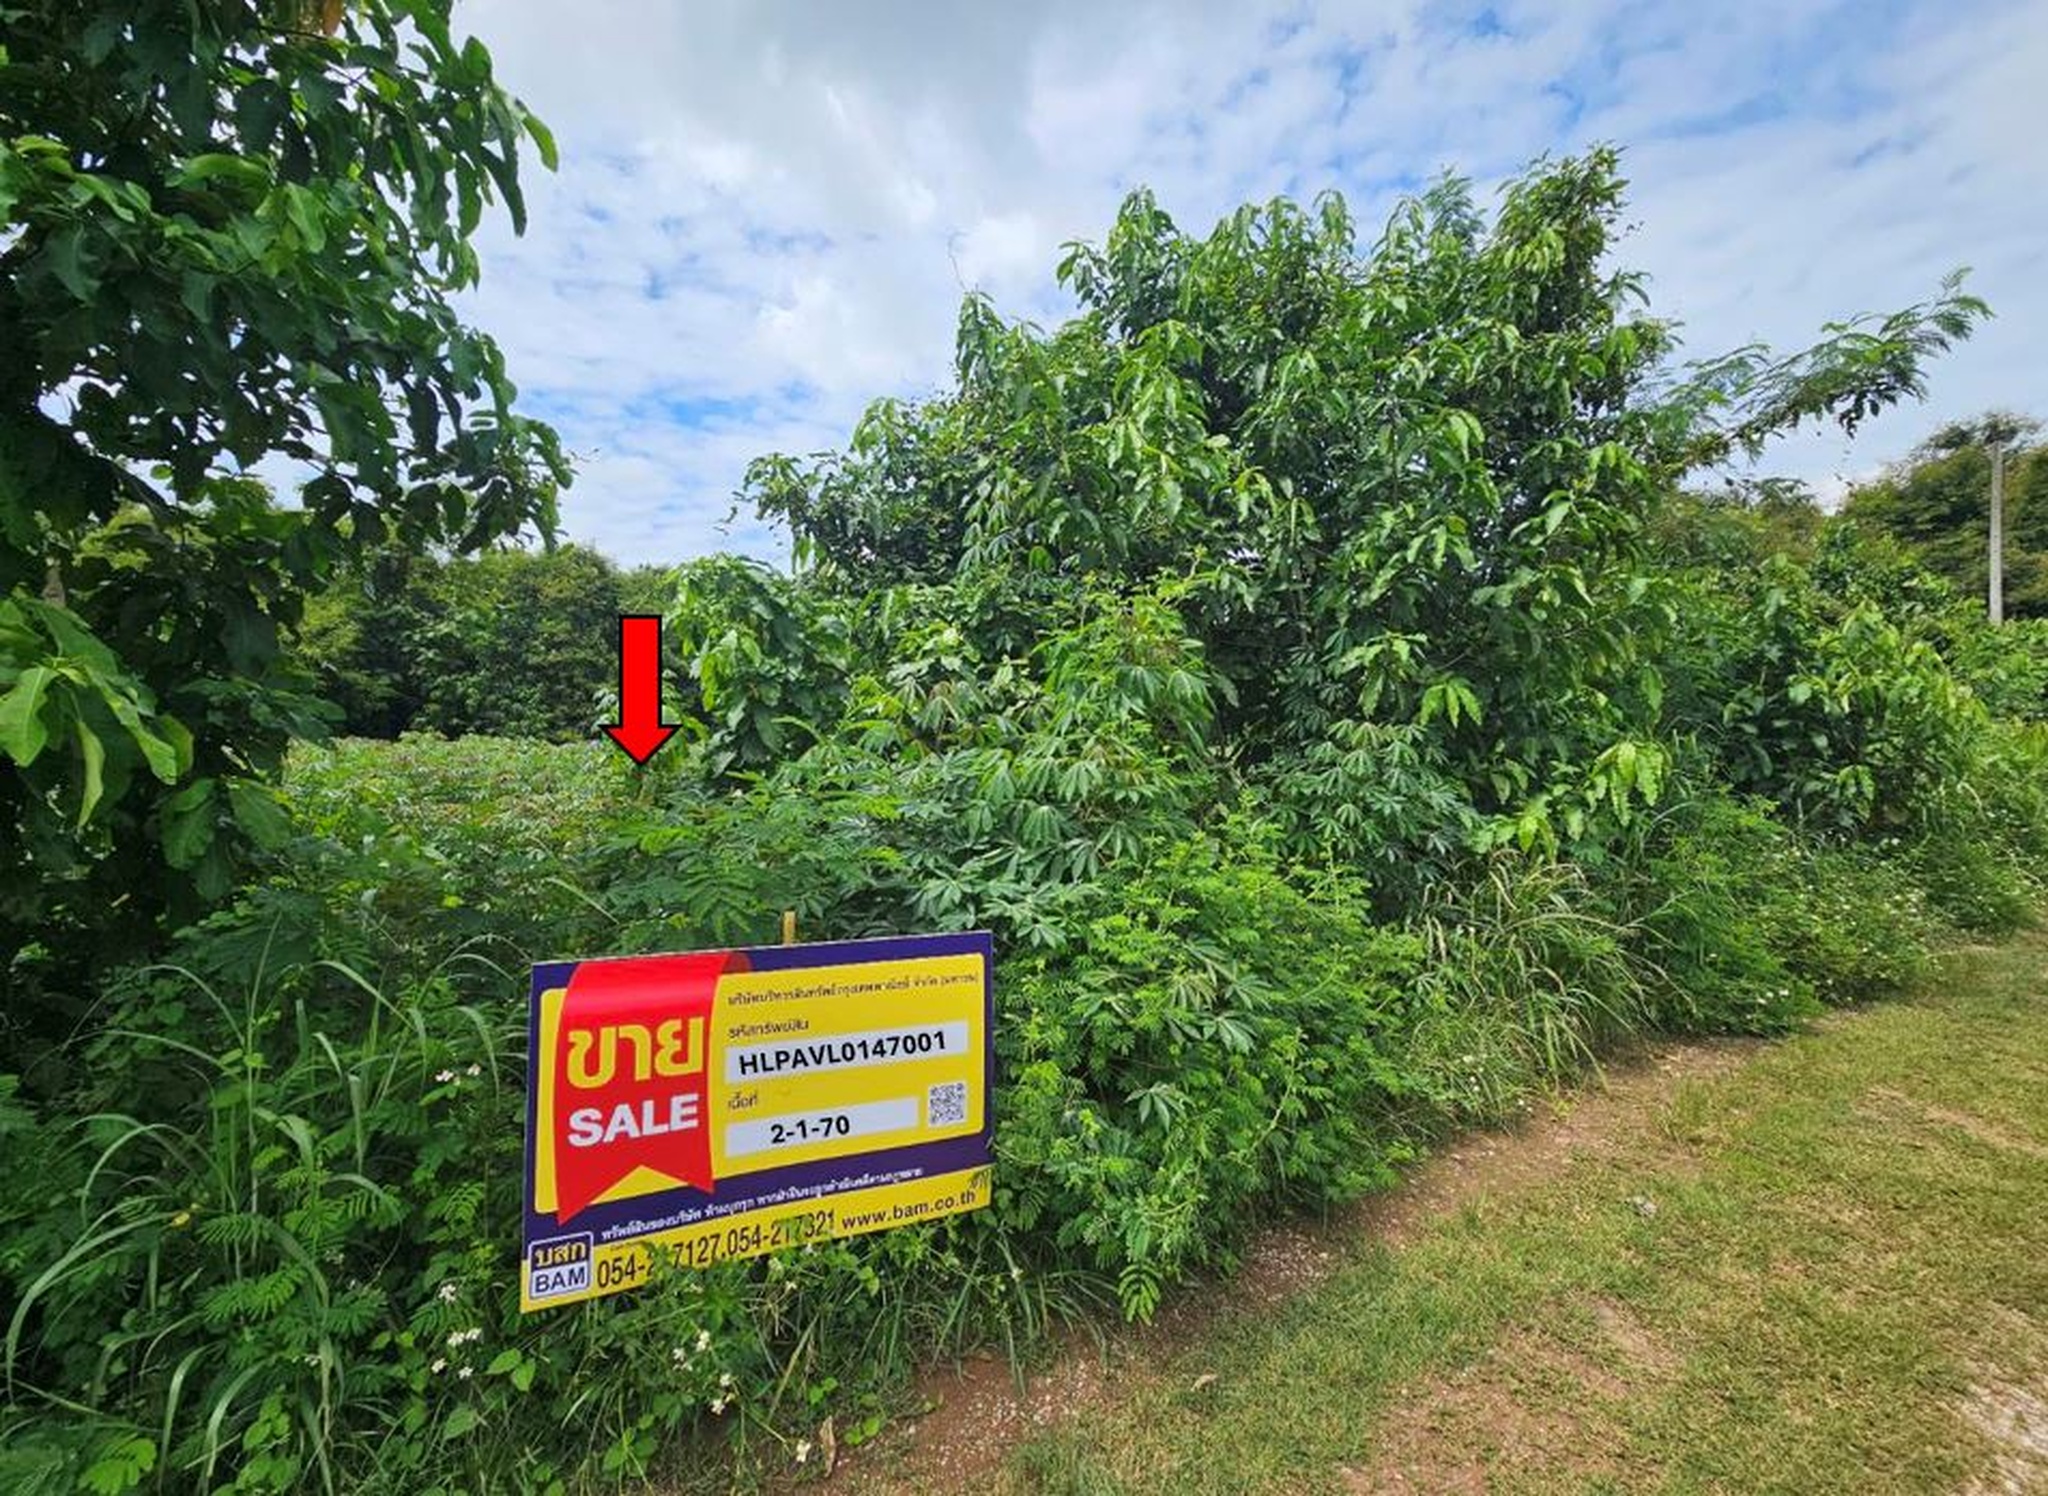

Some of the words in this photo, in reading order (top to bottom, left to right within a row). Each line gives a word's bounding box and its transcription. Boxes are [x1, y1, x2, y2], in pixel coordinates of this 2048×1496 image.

[567, 1016, 704, 1089] ขาย
[739, 1031, 945, 1075] HLPAVL0147001
[567, 1093, 699, 1147] SALE
[770, 1115, 850, 1144] 2-1-70
[841, 1190, 976, 1229] www.bam.co.th
[534, 1242, 586, 1267] บสก
[535, 1266, 585, 1293] BAM
